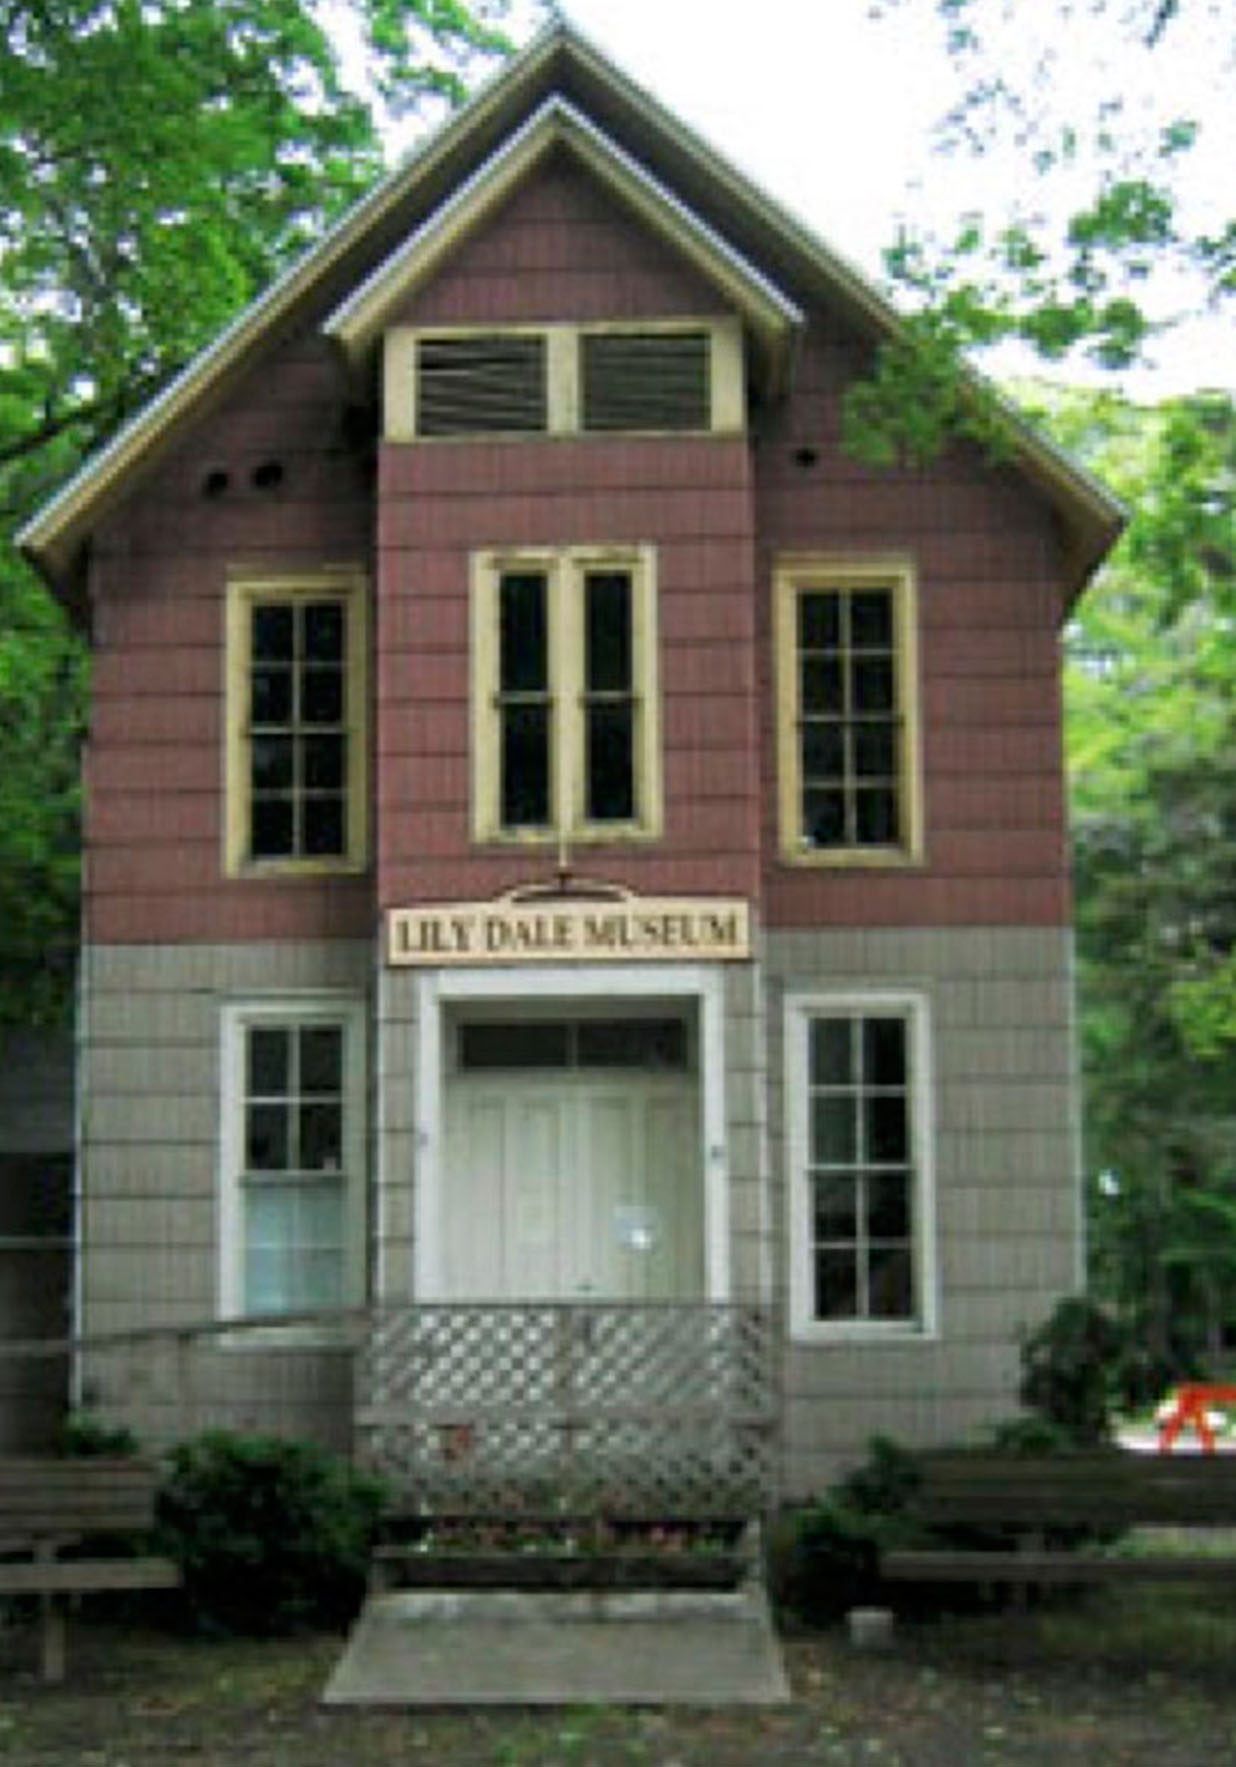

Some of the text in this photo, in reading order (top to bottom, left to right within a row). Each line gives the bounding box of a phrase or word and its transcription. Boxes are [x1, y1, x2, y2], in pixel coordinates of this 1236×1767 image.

[399, 914, 737, 951] LILY DALE MUSEUM
